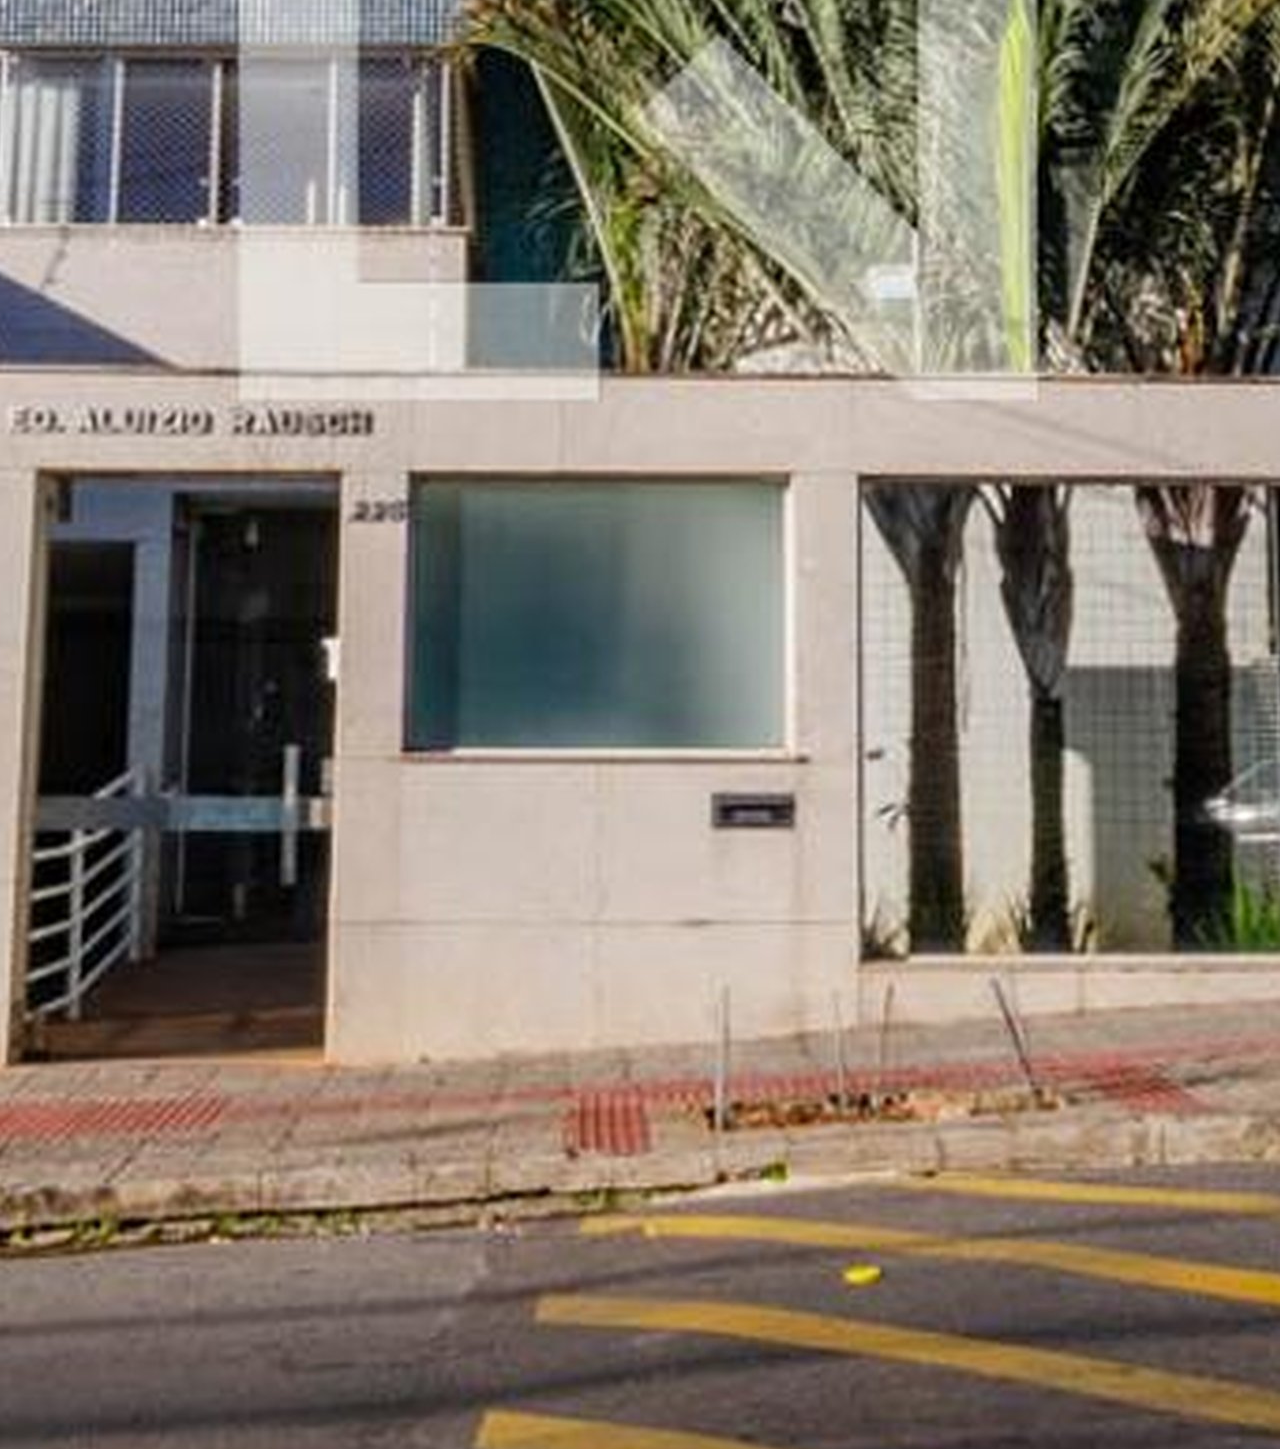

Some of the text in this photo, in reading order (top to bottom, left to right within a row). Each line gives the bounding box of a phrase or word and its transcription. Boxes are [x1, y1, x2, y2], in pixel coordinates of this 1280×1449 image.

[9, 405, 373, 436] ED. ALUIZIO RAUSCH
